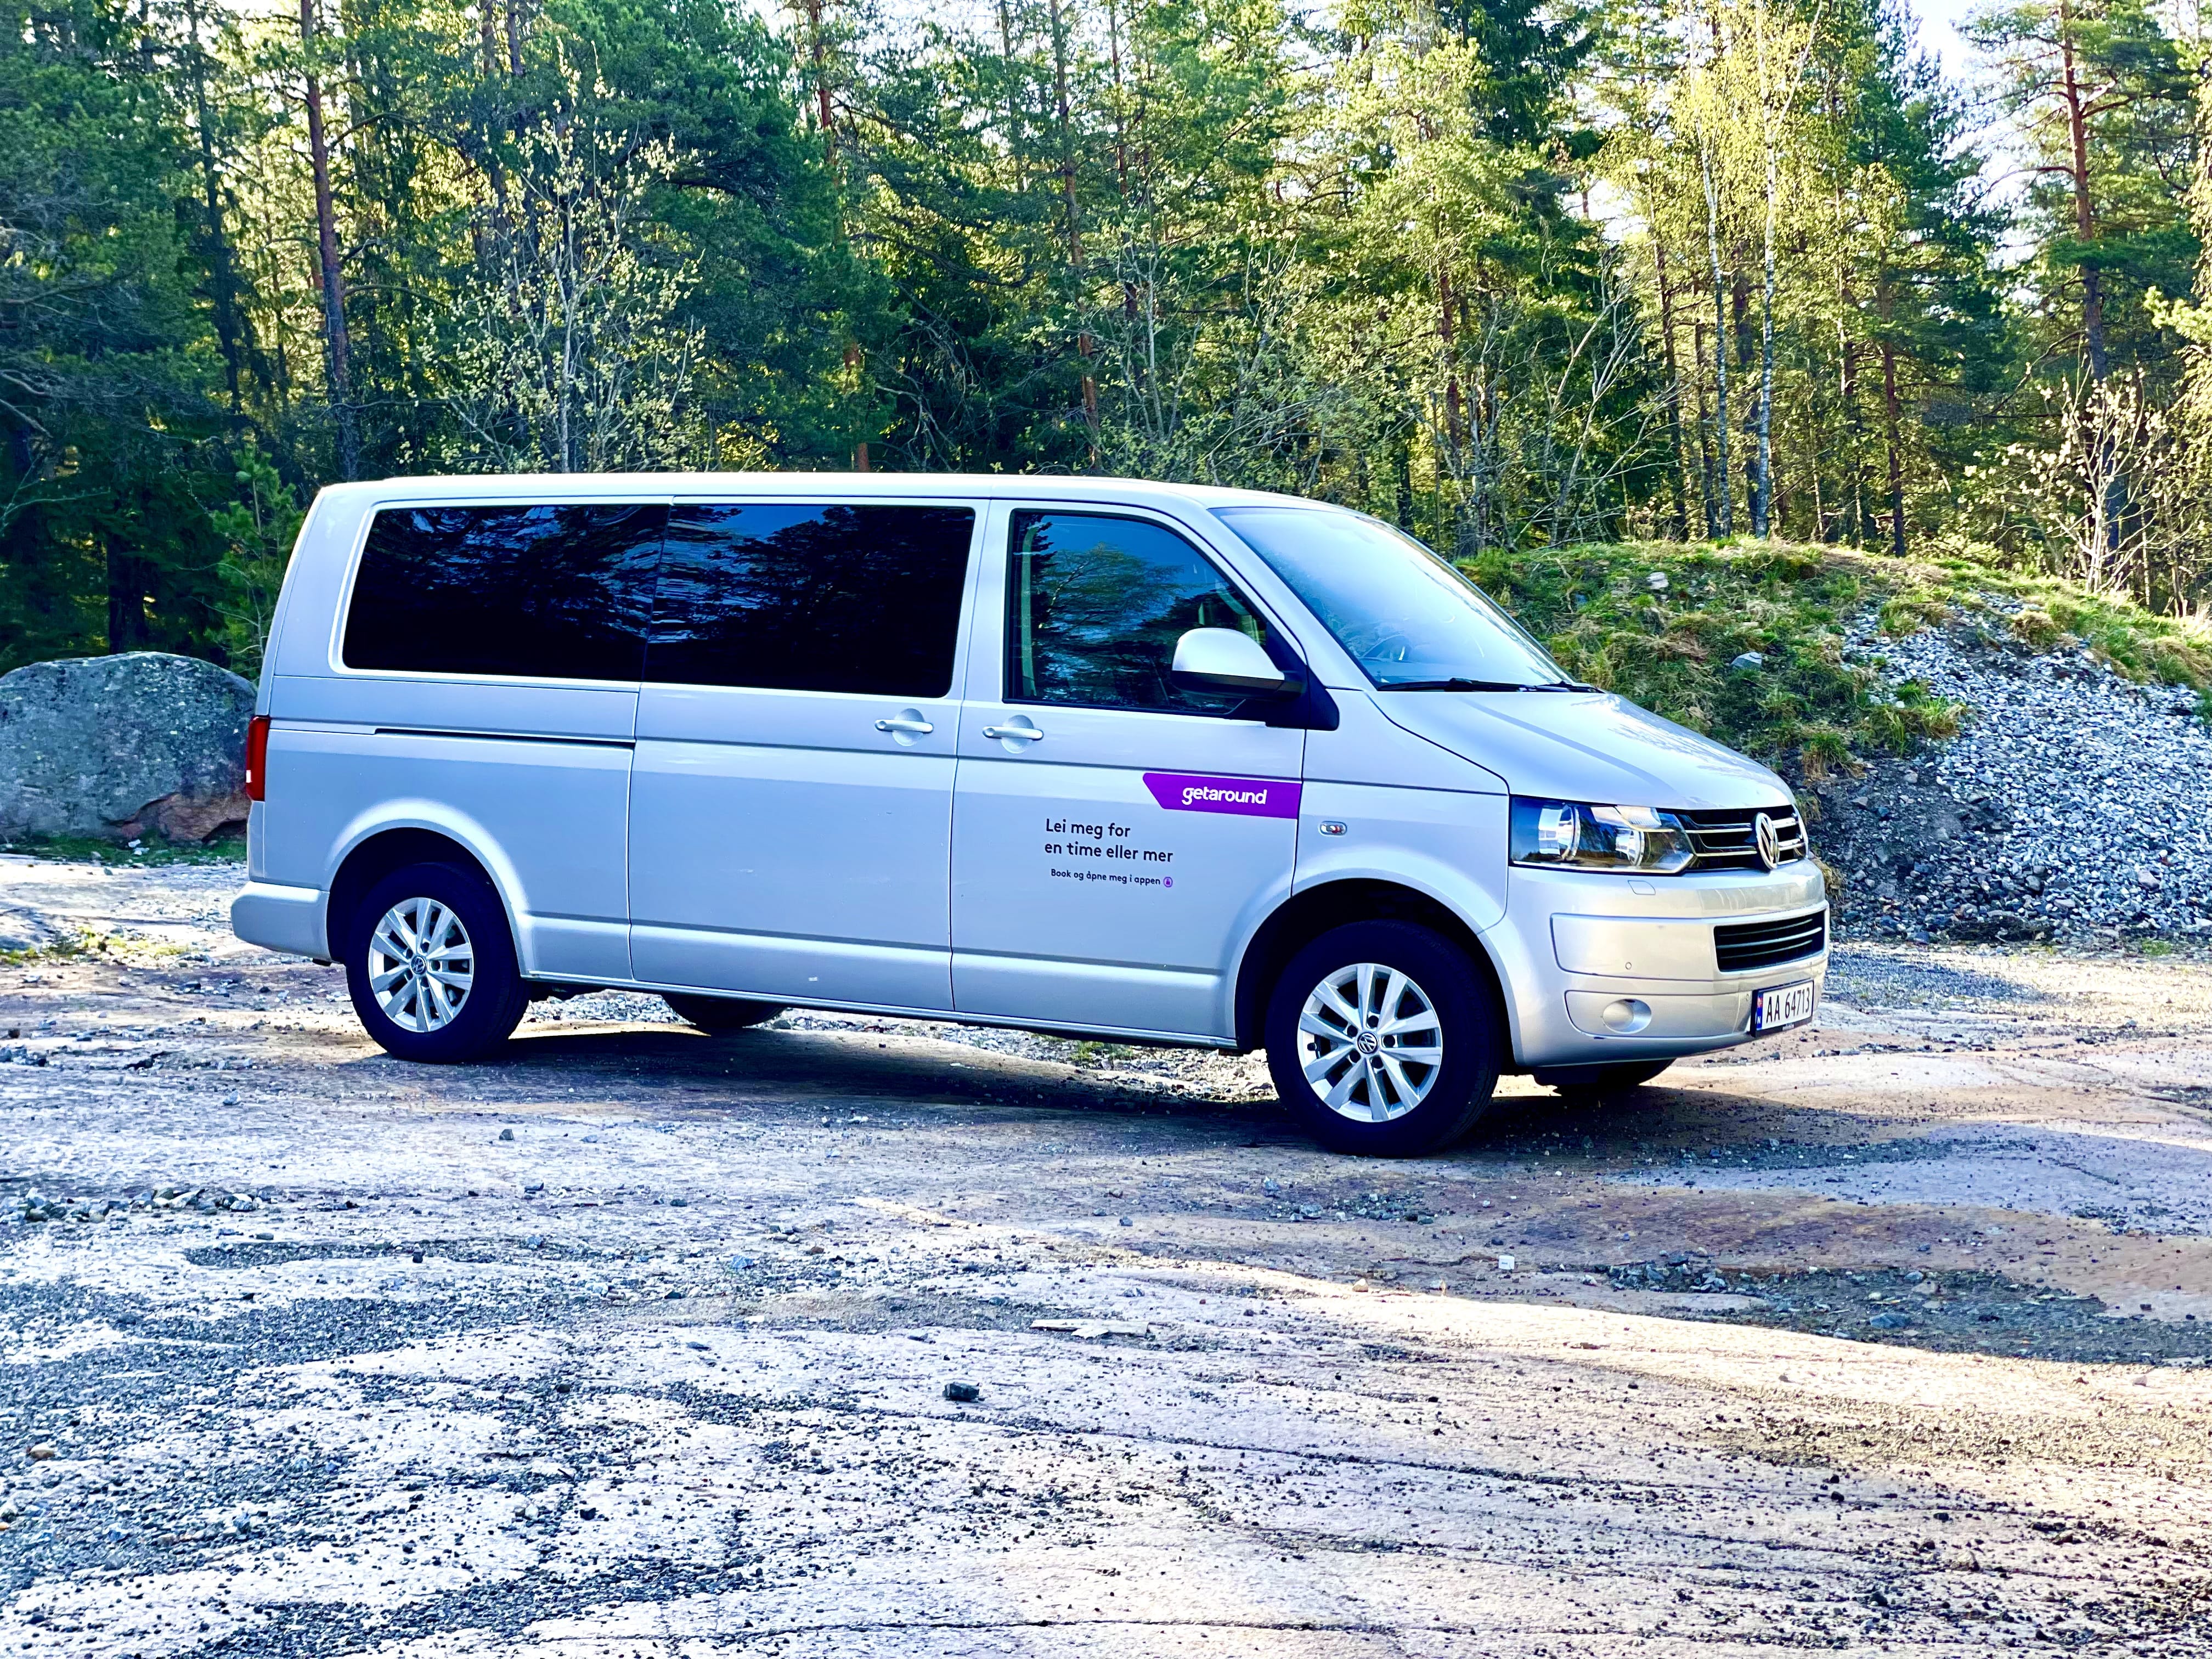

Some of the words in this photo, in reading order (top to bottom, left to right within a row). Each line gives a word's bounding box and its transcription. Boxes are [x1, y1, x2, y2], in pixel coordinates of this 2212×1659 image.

[1181, 786, 1268, 805] getaround
[1046, 818, 1066, 833] Lei
[1070, 823, 1103, 839] meg
[1108, 822, 1131, 837] for
[1045, 843, 1062, 854] en
[1066, 841, 1102, 857] time
[1106, 844, 1138, 860] eller
[1143, 850, 1173, 862] mer
[1051, 868, 1071, 878] Book
[1074, 872, 1084, 881] og
[1086, 871, 1107, 882] åpne
[1109, 874, 1127, 884] meg
[1129, 874, 1132, 883] i
[1134, 876, 1161, 887] appen
[1766, 995, 1780, 1024] AA
[1785, 987, 1810, 1019] 64713
